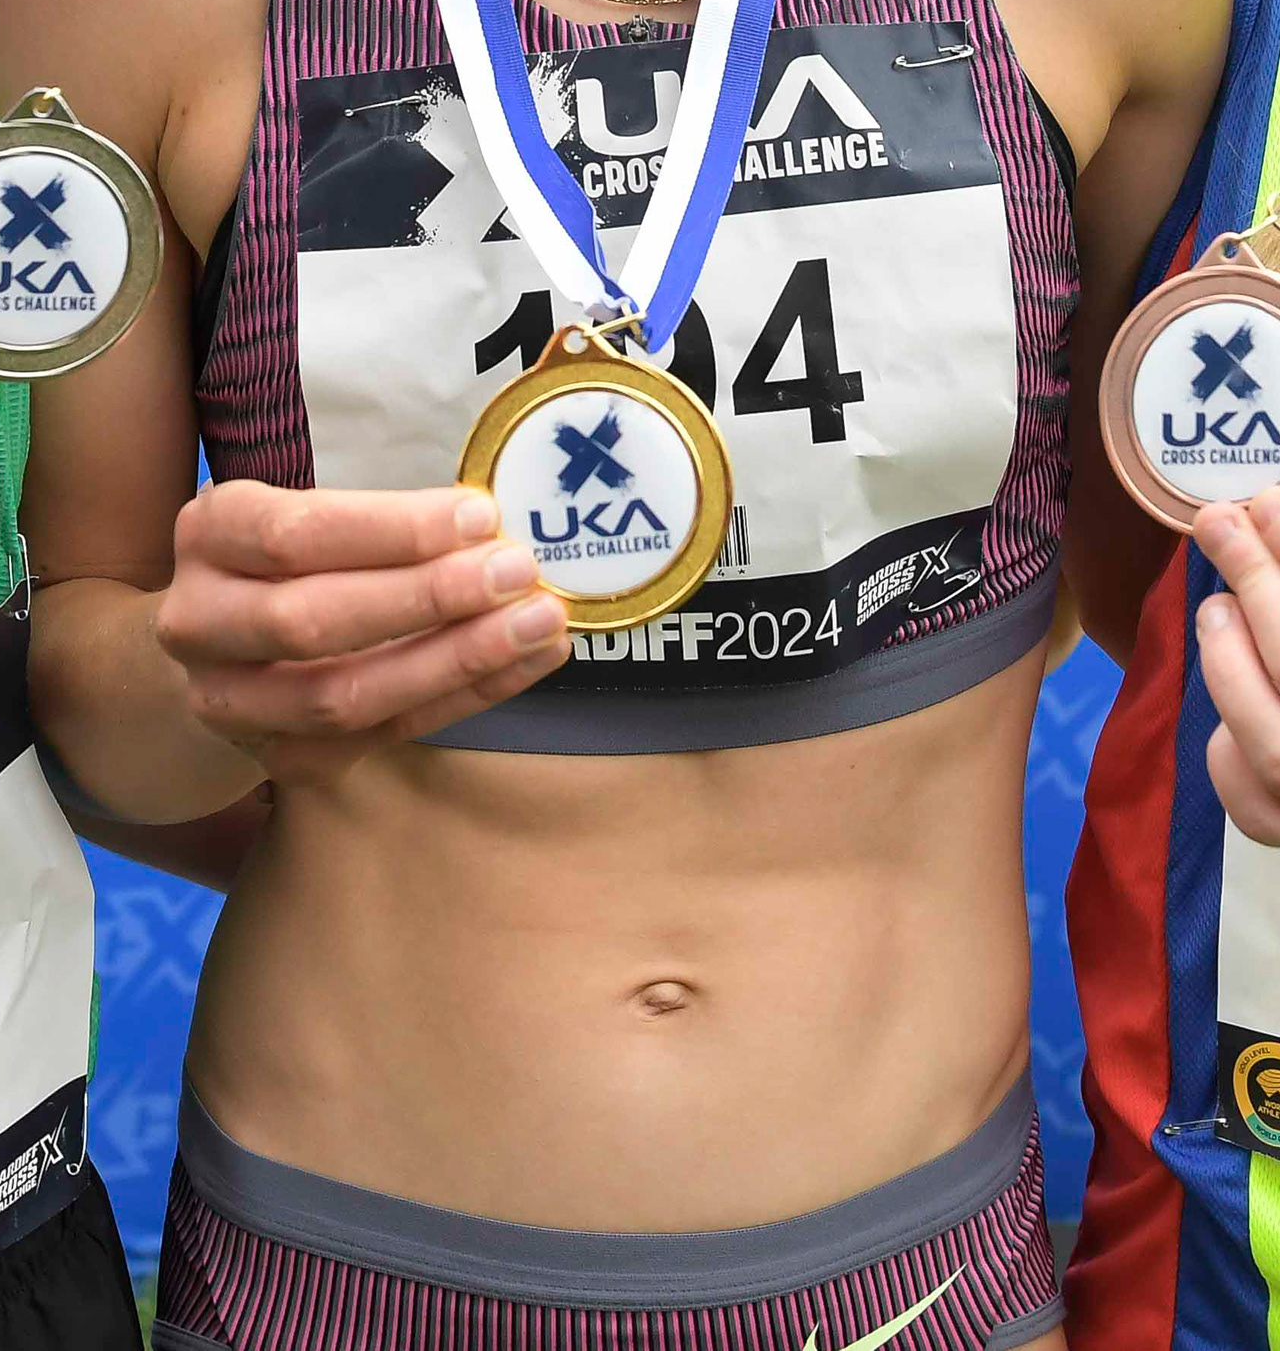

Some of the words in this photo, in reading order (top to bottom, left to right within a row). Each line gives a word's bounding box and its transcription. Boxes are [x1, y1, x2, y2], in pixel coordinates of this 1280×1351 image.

[575, 54, 881, 157] UA
[14, 296, 96, 311] CHALLENGE
[1162, 449, 1206, 465] CROSS
[530, 499, 668, 543] UKA
[533, 543, 582, 562] CROSS
[586, 534, 671, 556] CHALLENGE
[858, 552, 920, 597] CARDIFF
[858, 566, 916, 614] CROSS
[857, 581, 912, 626] CHALLENGE
[1238, 1056, 1251, 1074] GOLD
[1249, 1047, 1271, 1059] LEVEL
[1256, 1124, 1277, 1141] WORLD
